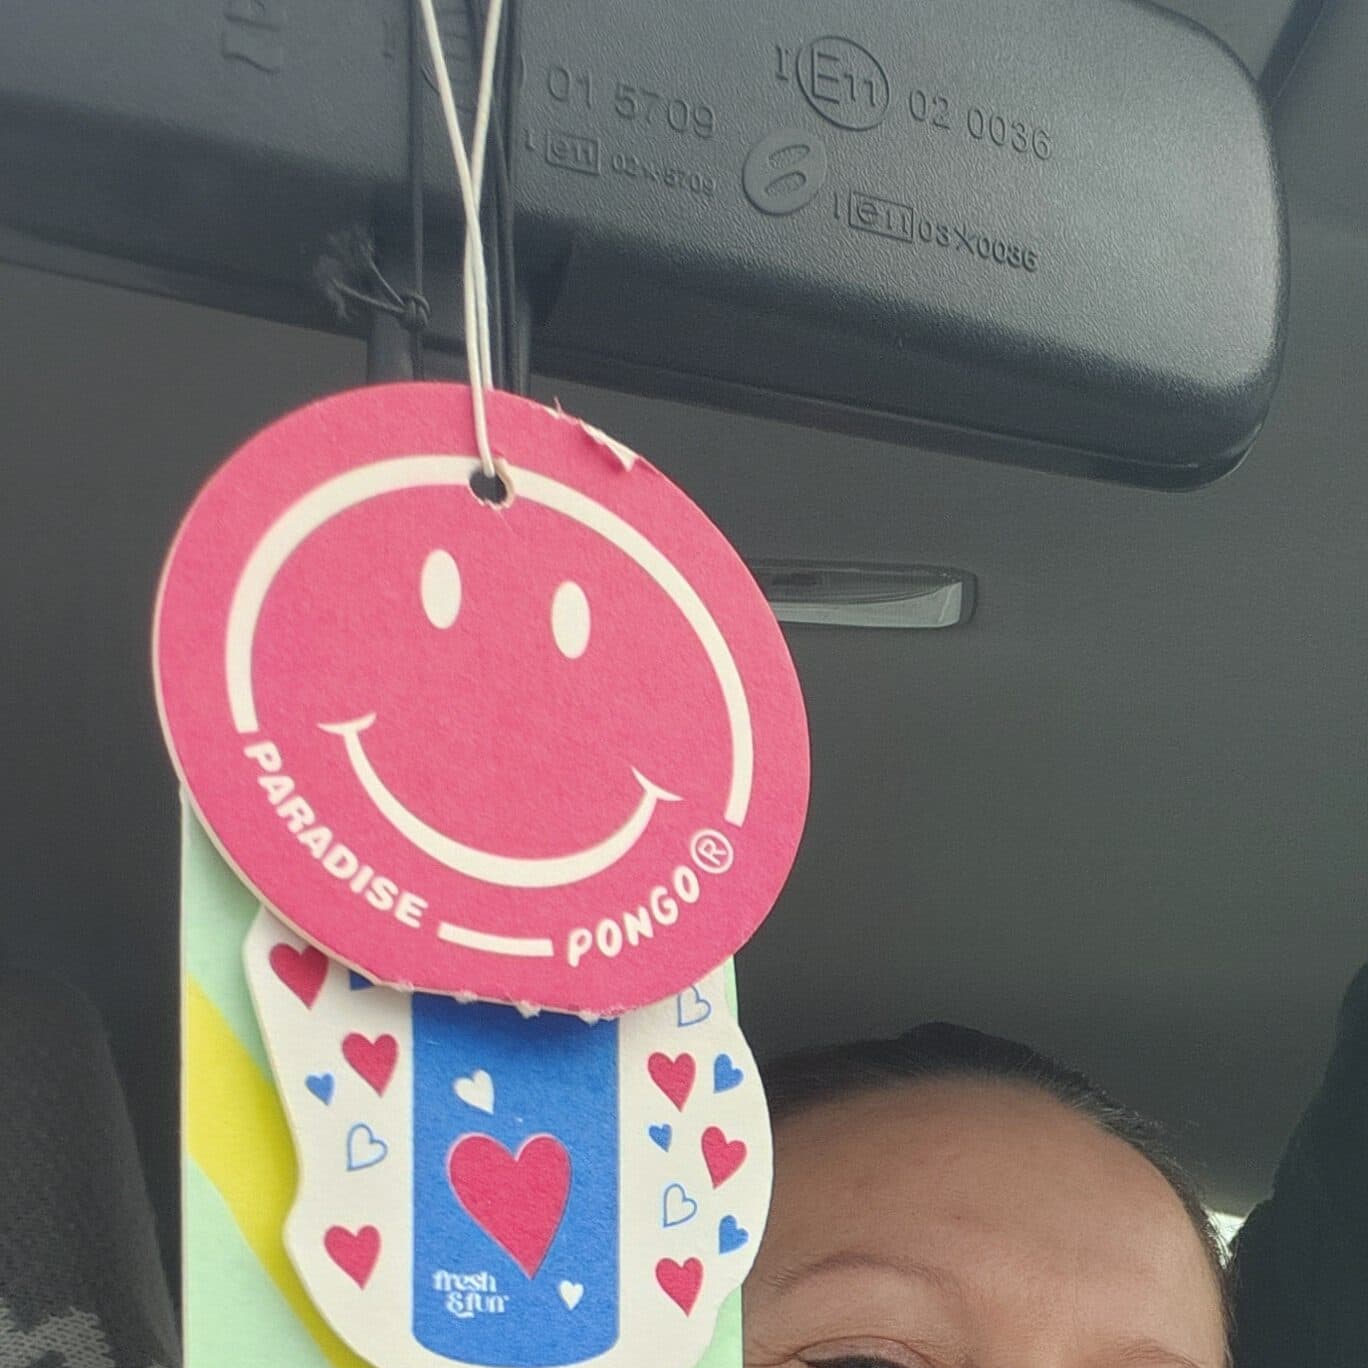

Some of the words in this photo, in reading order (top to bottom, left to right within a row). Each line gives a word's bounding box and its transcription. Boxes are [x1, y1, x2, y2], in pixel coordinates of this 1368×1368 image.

[614, 80, 716, 140] 5709
[909, 88, 951, 131] 02
[967, 107, 1051, 161] 0036
[243, 741, 428, 928] PARADISE
[432, 1270, 497, 1293] fresh
